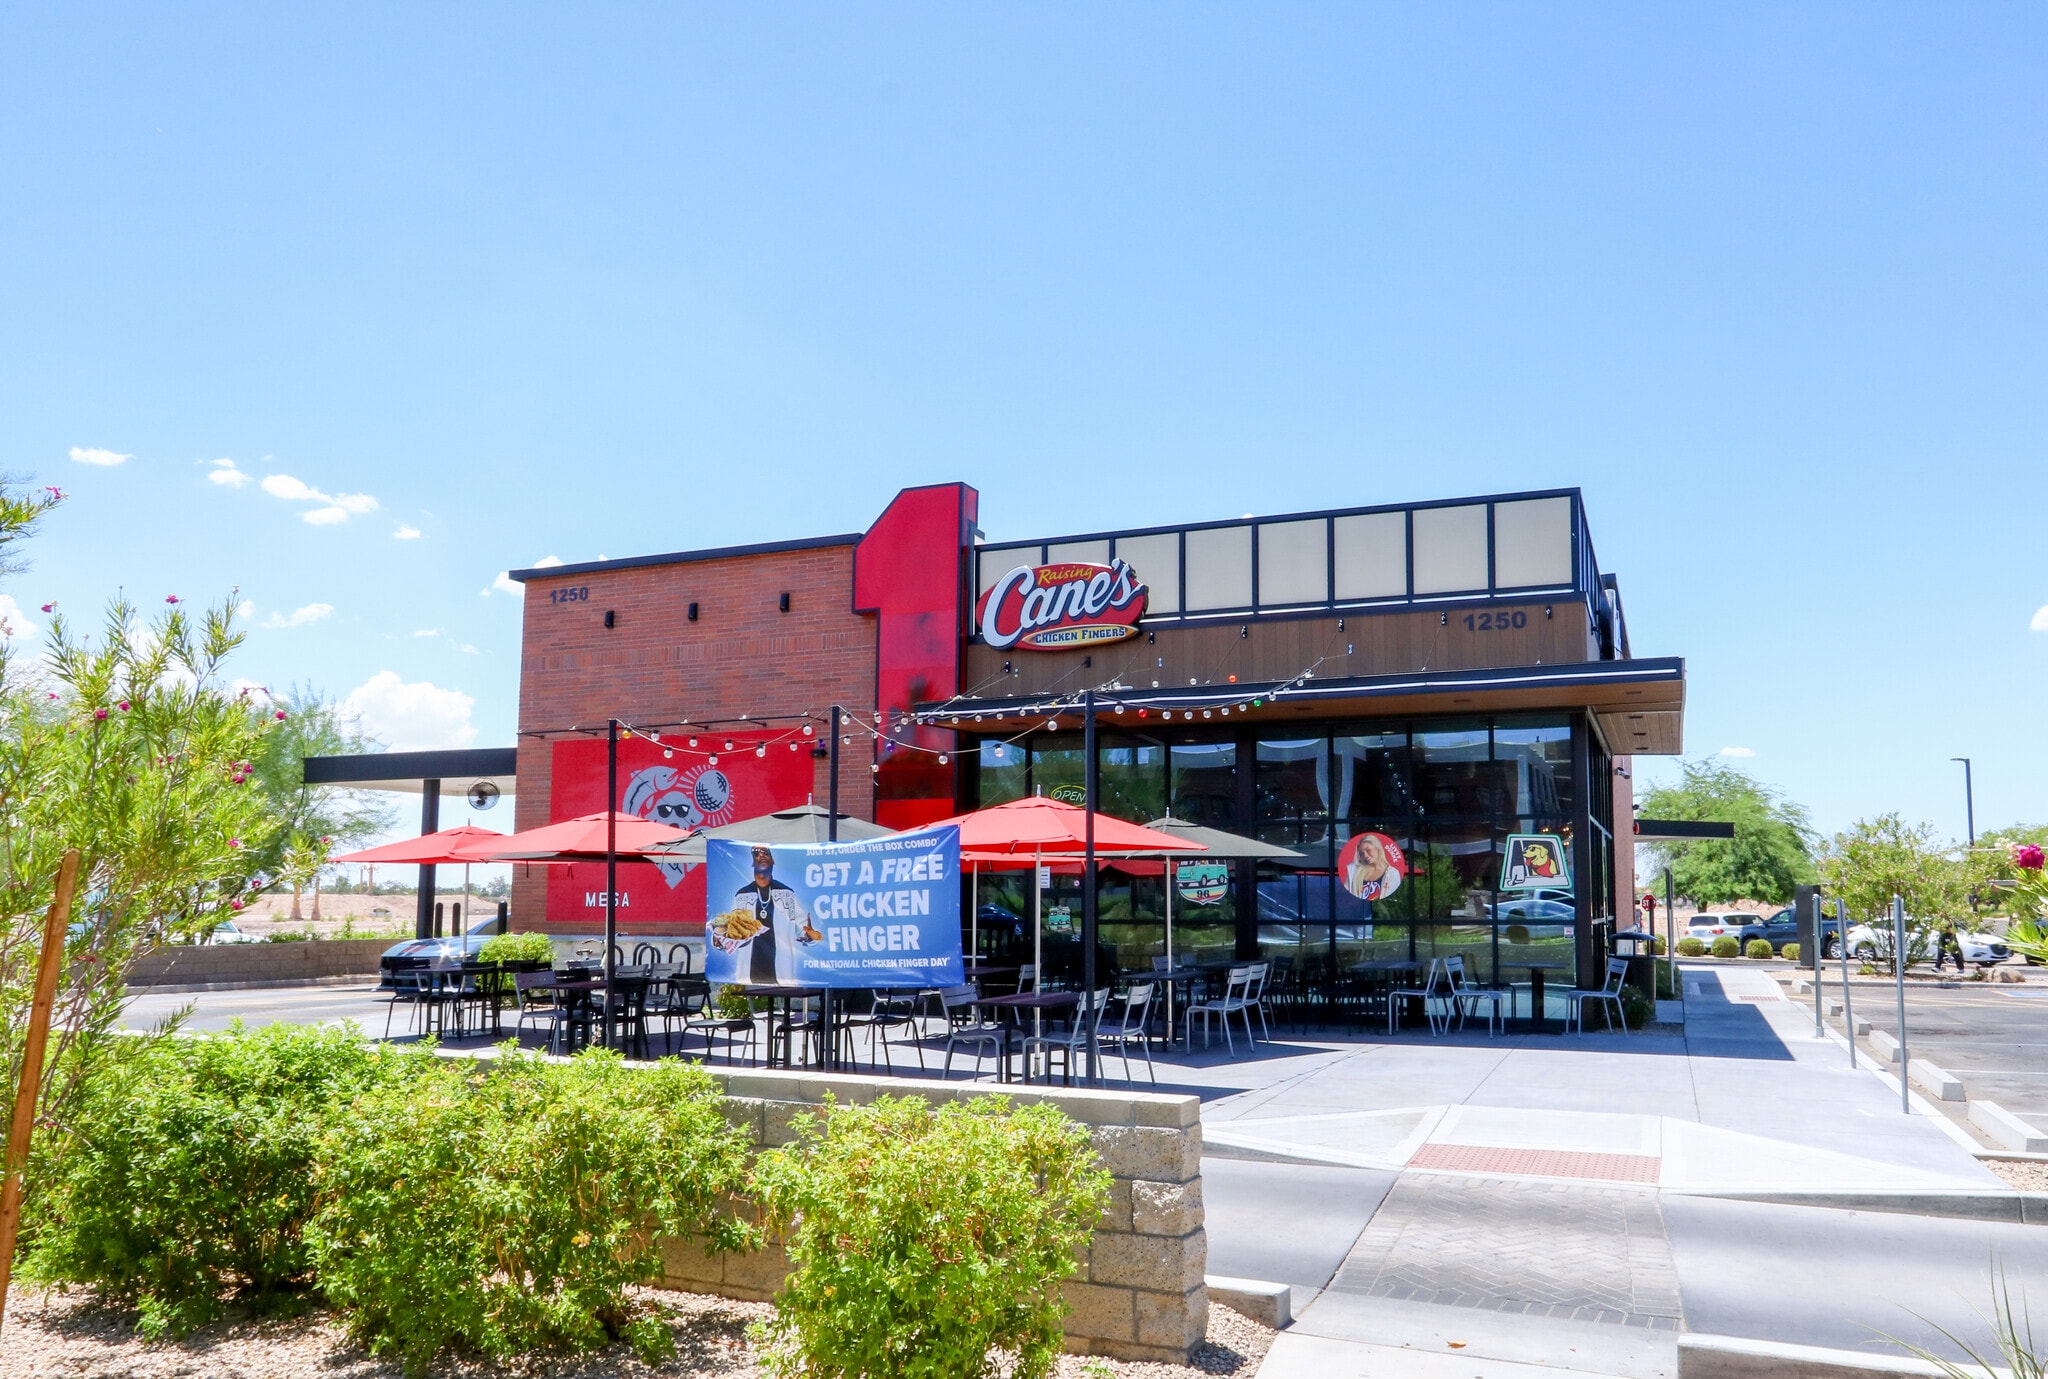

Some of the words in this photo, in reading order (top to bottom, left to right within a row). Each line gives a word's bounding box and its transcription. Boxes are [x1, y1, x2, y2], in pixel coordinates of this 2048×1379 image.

[1037, 566, 1093, 586] Raising
[550, 586, 589, 604] 1250
[982, 558, 1145, 648] Cane's
[1463, 611, 1527, 632] 1250
[1035, 632, 1078, 644] CHICKEN
[1081, 627, 1126, 641] FINGERS
[1053, 790, 1086, 803] OPEN
[838, 844, 866, 855] ORDER
[867, 842, 884, 852] THE
[884, 840, 904, 851] BOX
[805, 861, 851, 888] GET
[856, 860, 874, 886] A
[879, 853, 944, 884] FREE
[1197, 890, 1210, 898] 96
[1643, 899, 1656, 907] ST
[813, 889, 930, 920] CHICKEN
[827, 924, 921, 953] FINGER
[803, 959, 819, 969] FOR
[820, 959, 860, 969] NATIONAL
[861, 959, 898, 968] CHICKEN
[899, 958, 929, 968] FINGER
